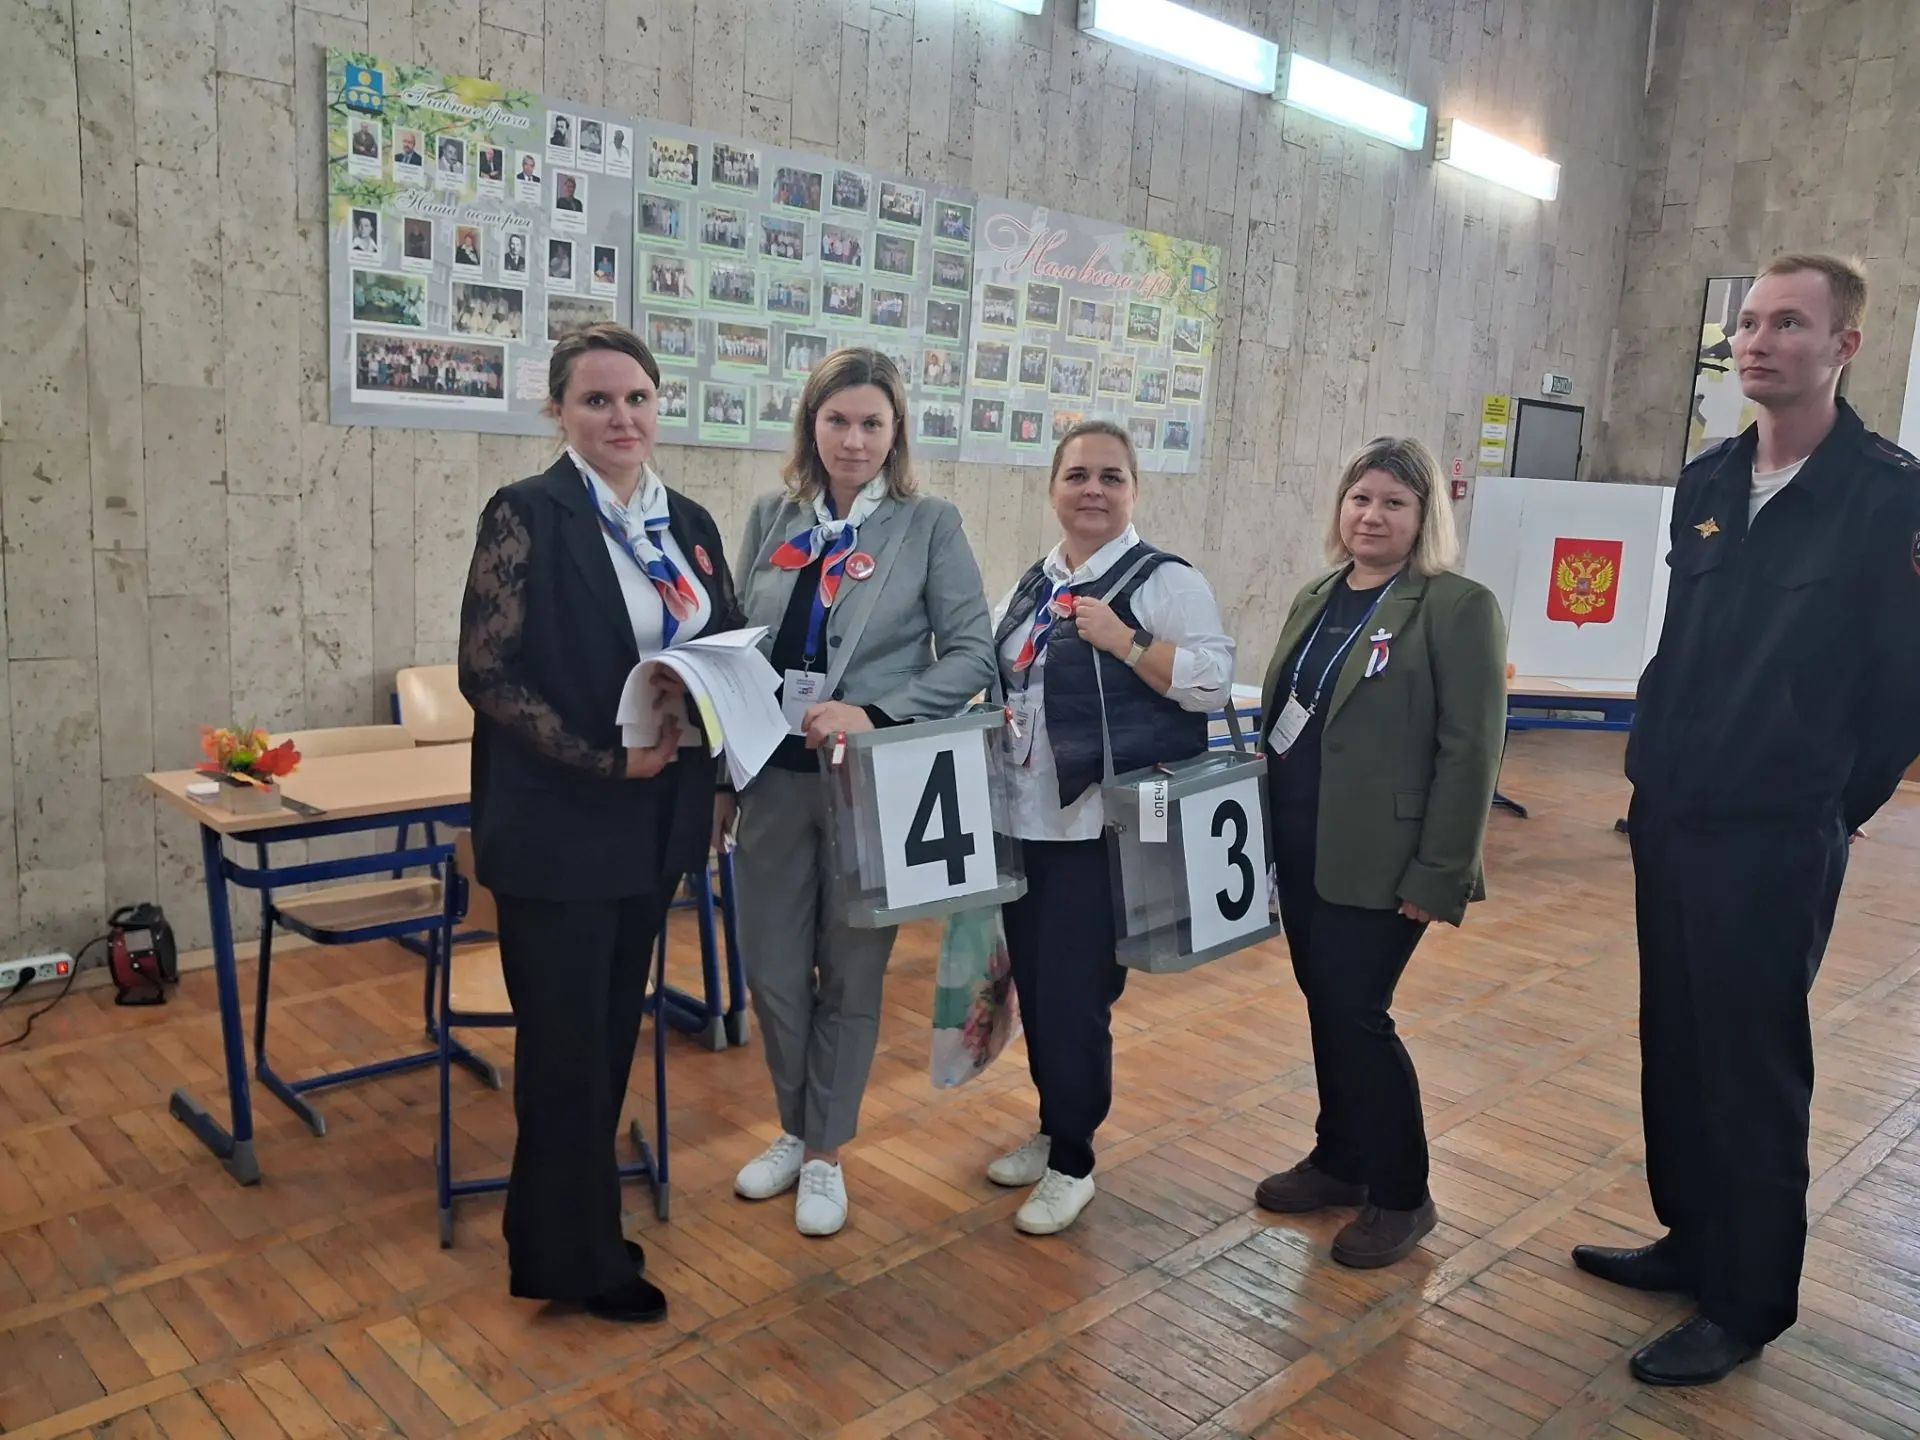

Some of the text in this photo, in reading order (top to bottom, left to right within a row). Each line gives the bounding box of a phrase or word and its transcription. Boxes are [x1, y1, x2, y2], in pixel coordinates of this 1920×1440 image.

[402, 85, 528, 128] Главные врачи
[398, 189, 457, 216] Наша
[466, 208, 532, 231] история
[985, 214, 1077, 281] Нам
[904, 749, 975, 886] 4
[1211, 799, 1255, 921] 3
